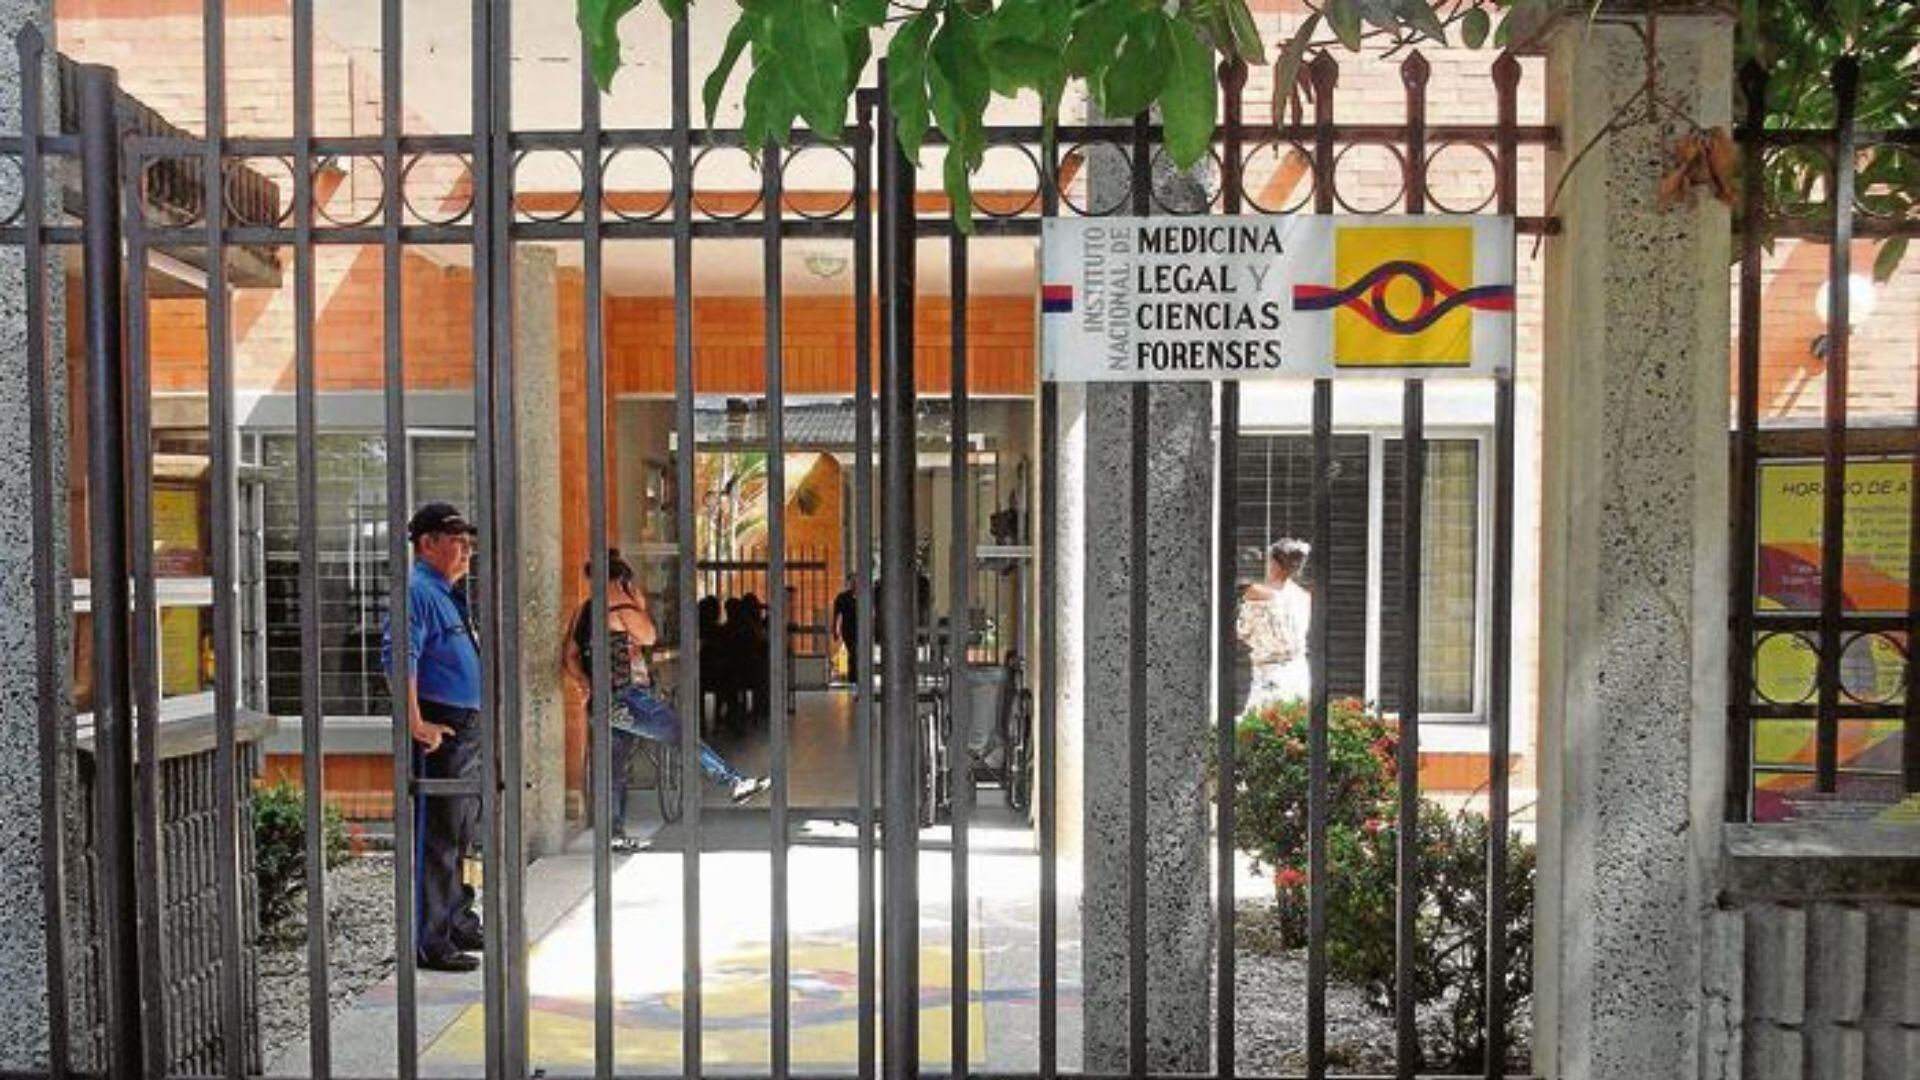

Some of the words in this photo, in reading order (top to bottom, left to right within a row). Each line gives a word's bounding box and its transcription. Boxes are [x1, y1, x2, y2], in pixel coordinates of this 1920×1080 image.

[1109, 226, 1131, 253] DE
[1137, 226, 1284, 254] MEDICINA
[1083, 226, 1106, 332] INSTITUTO
[1137, 264, 1237, 293] LEGAL
[1249, 265, 1270, 292] Y
[1108, 262, 1131, 370] NACIONAL
[1136, 302, 1280, 330] CIENCIAS
[1137, 340, 1282, 370] FORENSES
